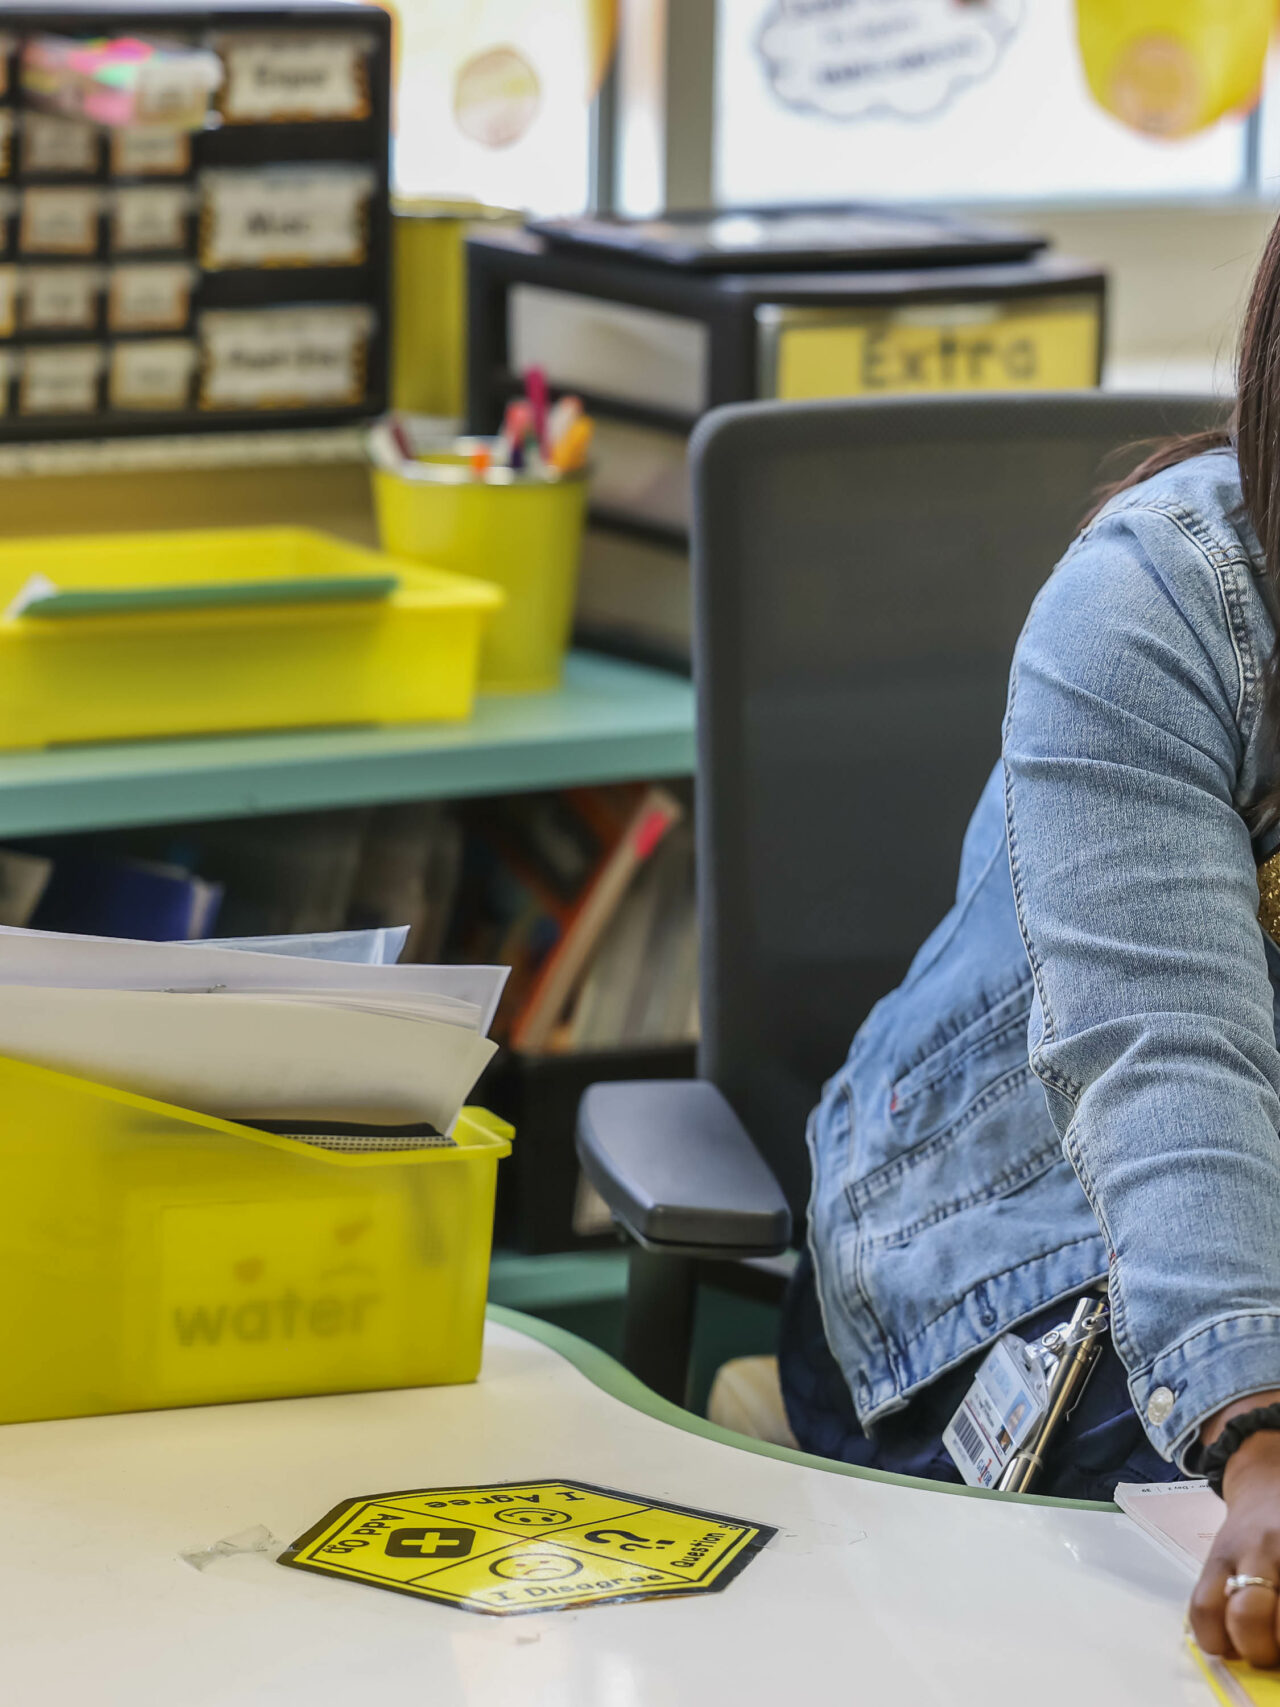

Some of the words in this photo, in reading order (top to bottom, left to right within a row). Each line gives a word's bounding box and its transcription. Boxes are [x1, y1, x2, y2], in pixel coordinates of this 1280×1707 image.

[860, 325, 1040, 390] Extra
[172, 1286, 385, 1347] water
[424, 1494, 540, 1508] Agree
[555, 1491, 585, 1501] I
[351, 1513, 405, 1535] Add
[670, 1531, 726, 1568] Question
[491, 1591, 515, 1601] I
[525, 1572, 665, 1598] Disagree
